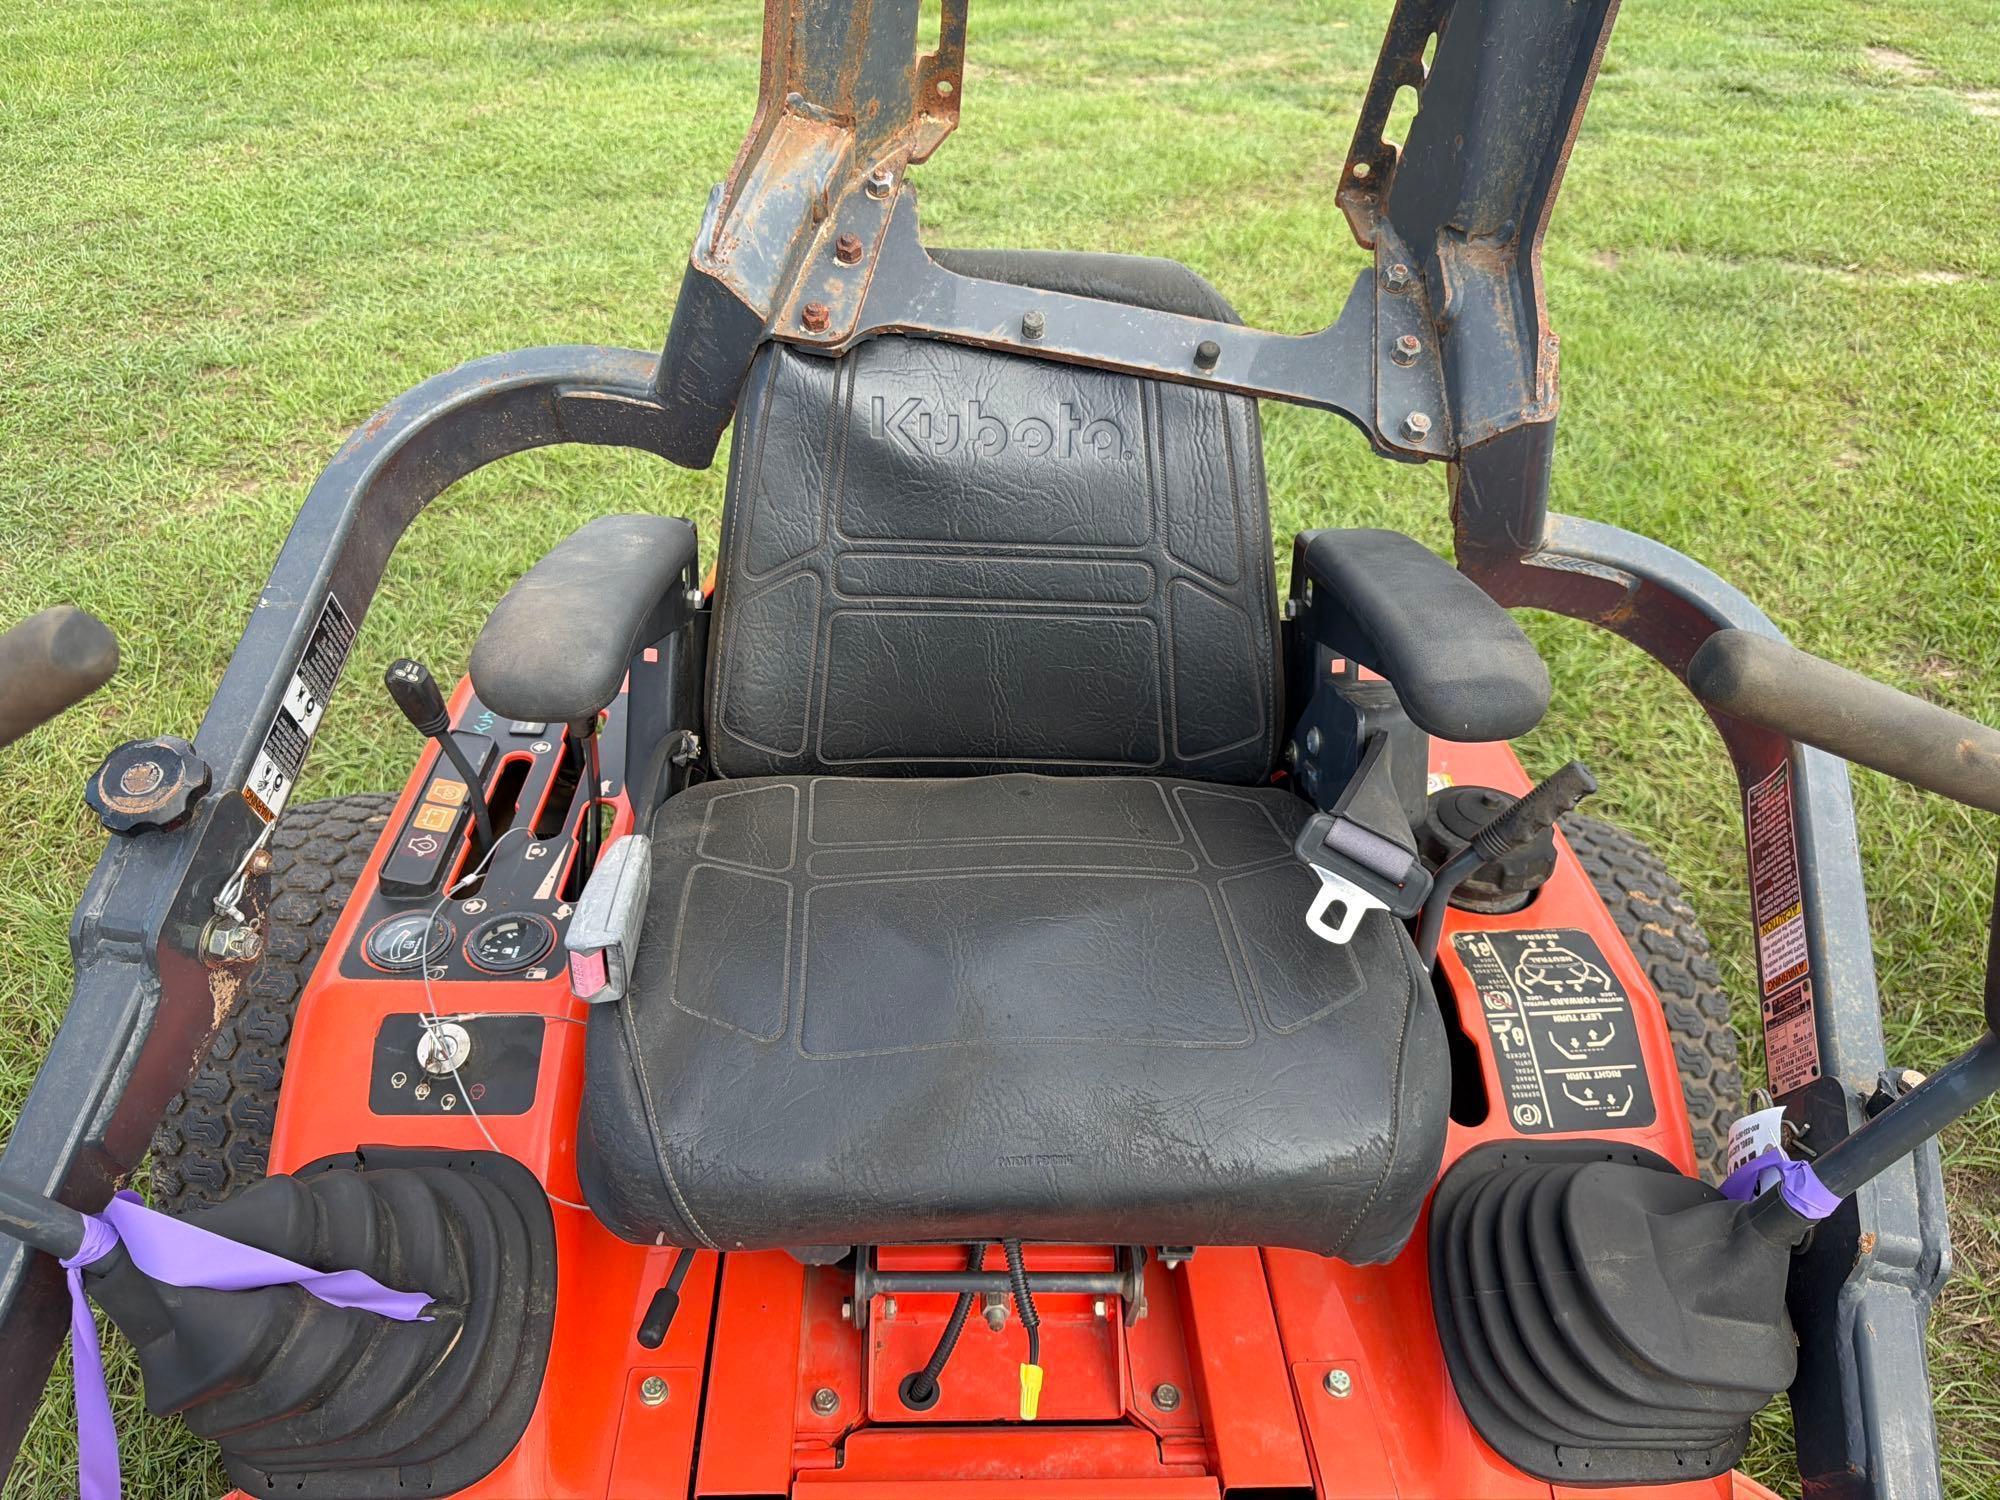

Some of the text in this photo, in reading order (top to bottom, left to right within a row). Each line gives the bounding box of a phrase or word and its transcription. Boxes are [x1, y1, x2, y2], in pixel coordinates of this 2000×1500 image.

[870, 395, 1123, 460] Kubota
[1762, 907, 1792, 935] CAUTION
[1767, 965, 1797, 991] WARNING
[1550, 996, 1597, 1006] FORWARD
[1553, 1012, 1602, 1022] LEFT TURN
[1566, 1070, 1621, 1080] RIGHT TURN
